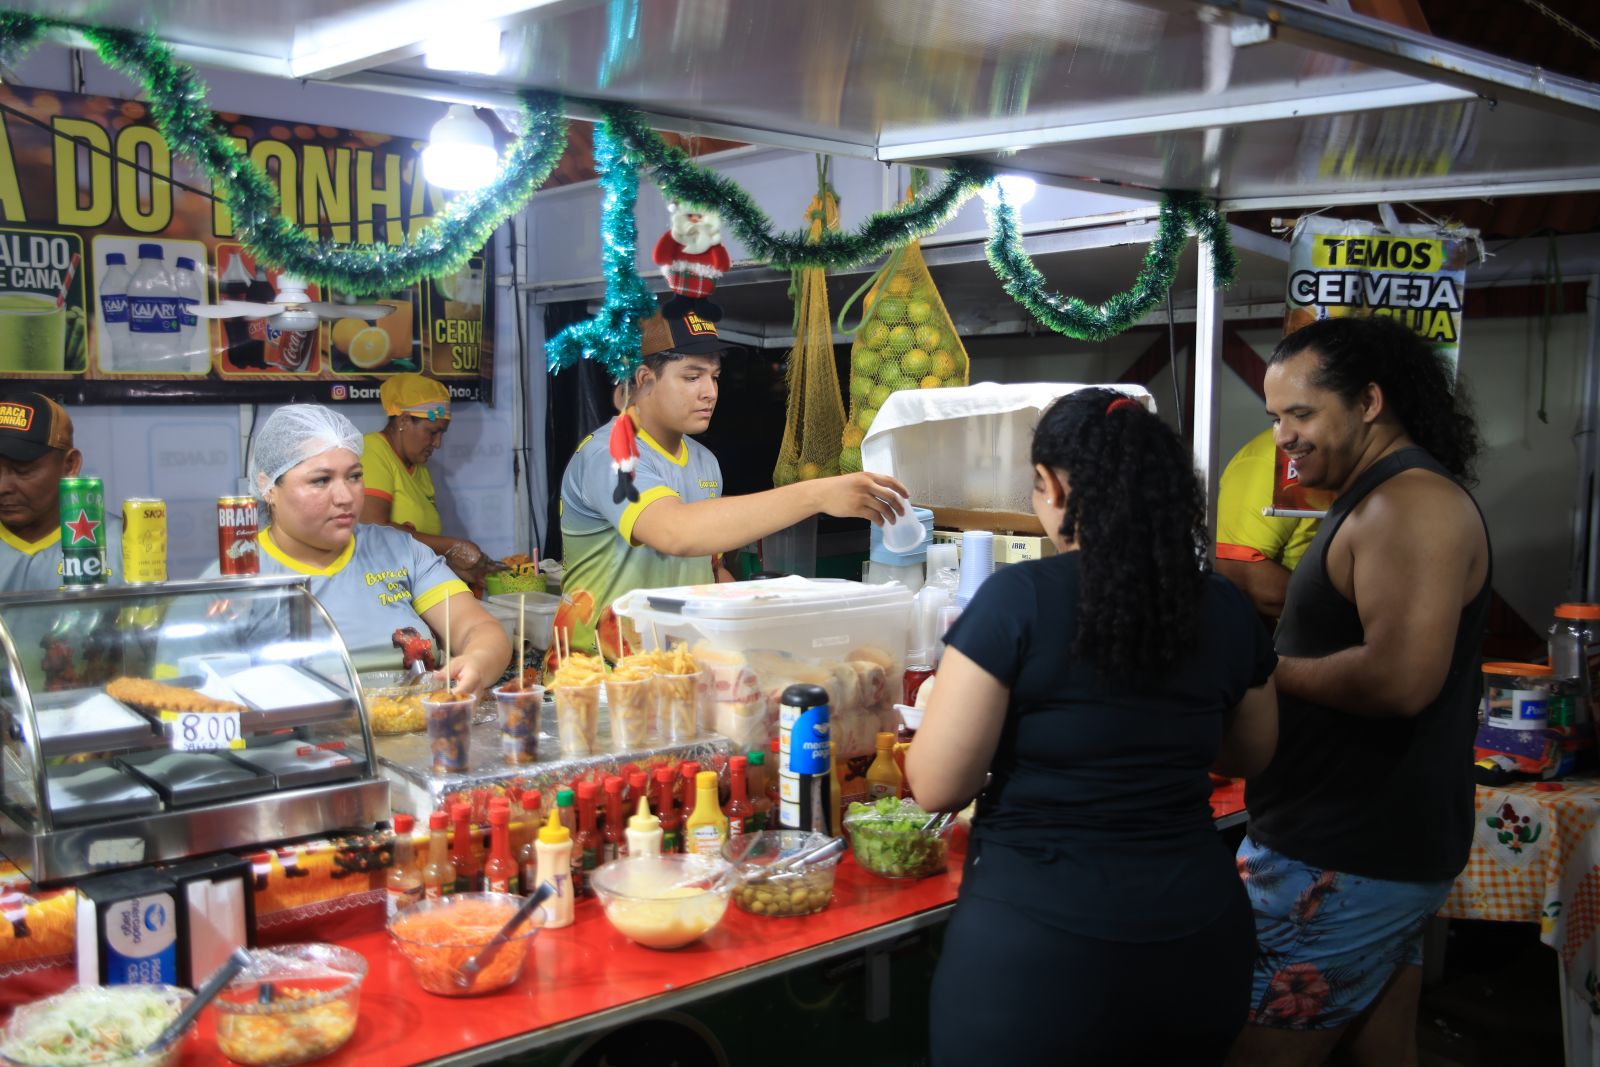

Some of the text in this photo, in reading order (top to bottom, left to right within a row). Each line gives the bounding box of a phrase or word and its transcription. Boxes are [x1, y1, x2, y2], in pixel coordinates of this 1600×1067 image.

[53, 117, 173, 233] DO
[1322, 238, 1432, 270] TEMOS
[11, 267, 65, 290] CANA
[1290, 271, 1460, 310] CERVEJA
